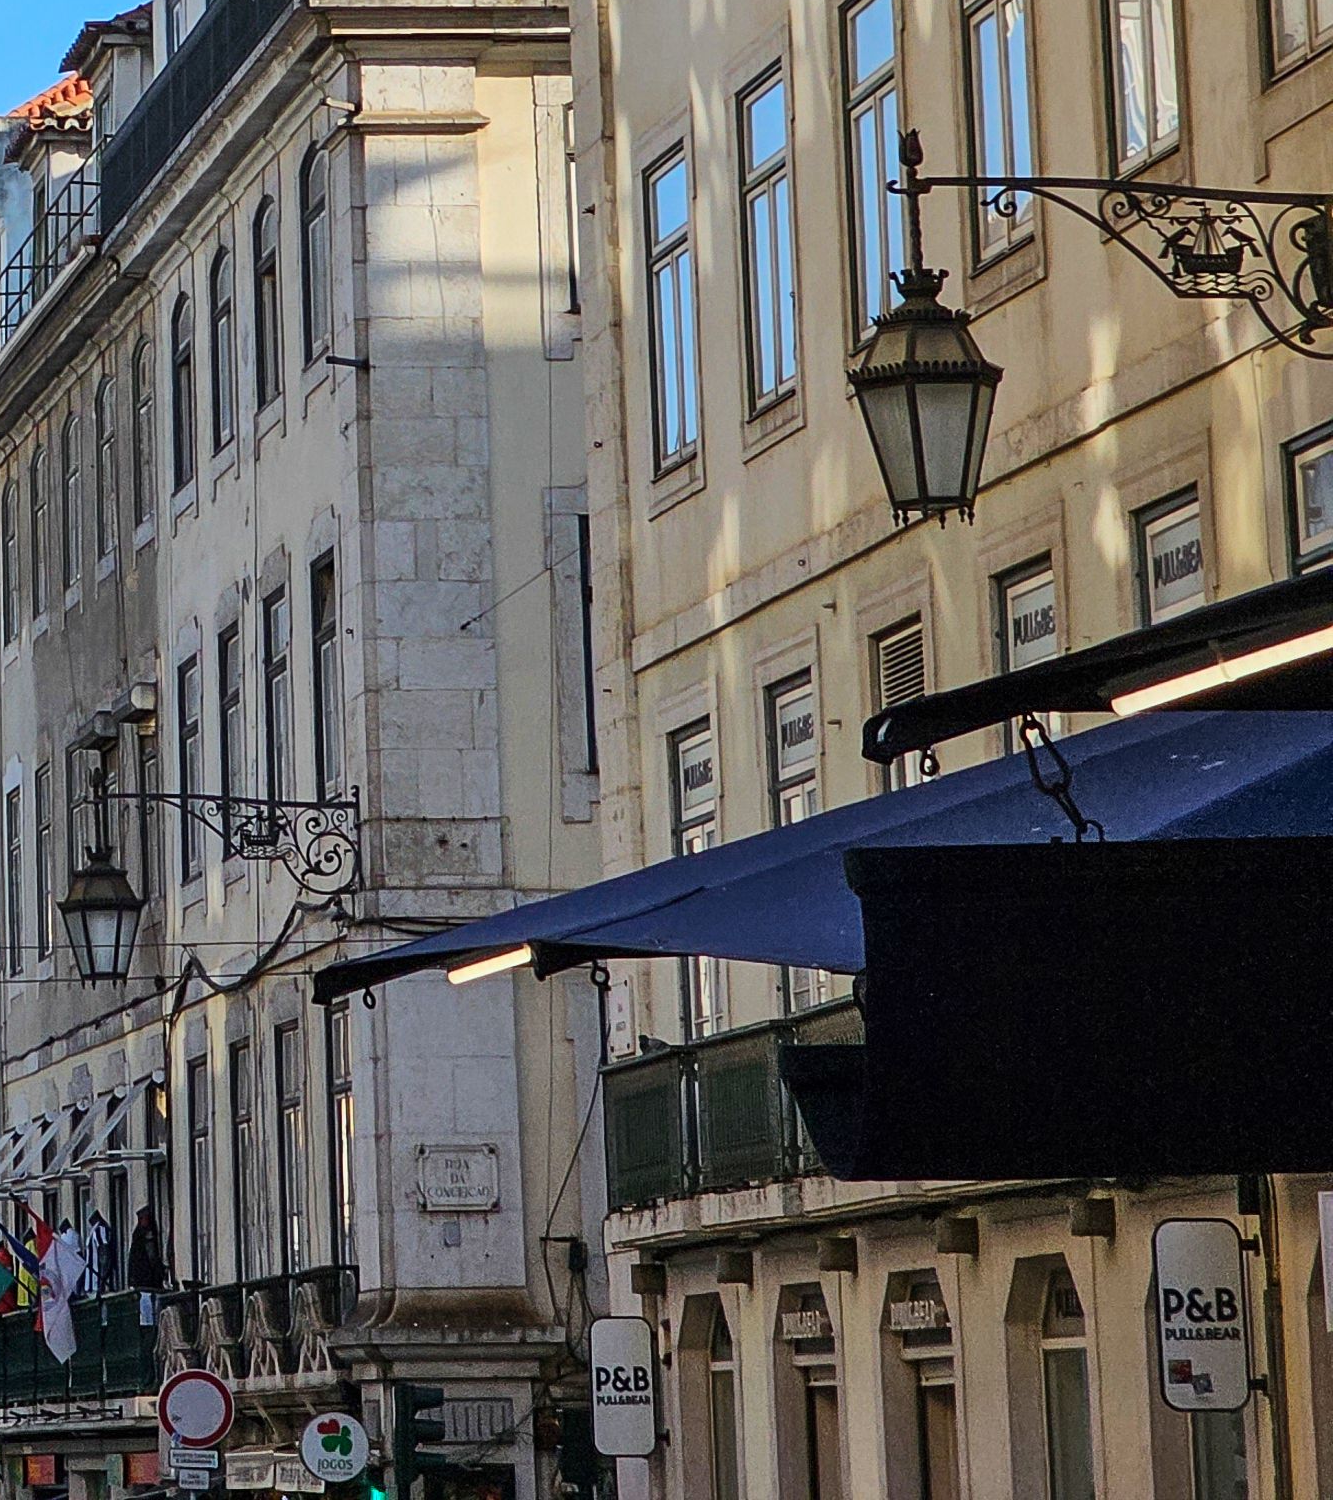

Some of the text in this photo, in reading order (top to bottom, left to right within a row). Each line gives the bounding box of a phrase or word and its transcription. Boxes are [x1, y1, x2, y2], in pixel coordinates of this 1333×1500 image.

[450, 1172, 466, 1183] DA
[1162, 1286, 1238, 1323] P&B
[1164, 1327, 1241, 1341] PULL&BEAR
[595, 1365, 650, 1392] P&B
[596, 1395, 651, 1406] PULL&BEAR
[317, 1458, 354, 1473] JOGOS
